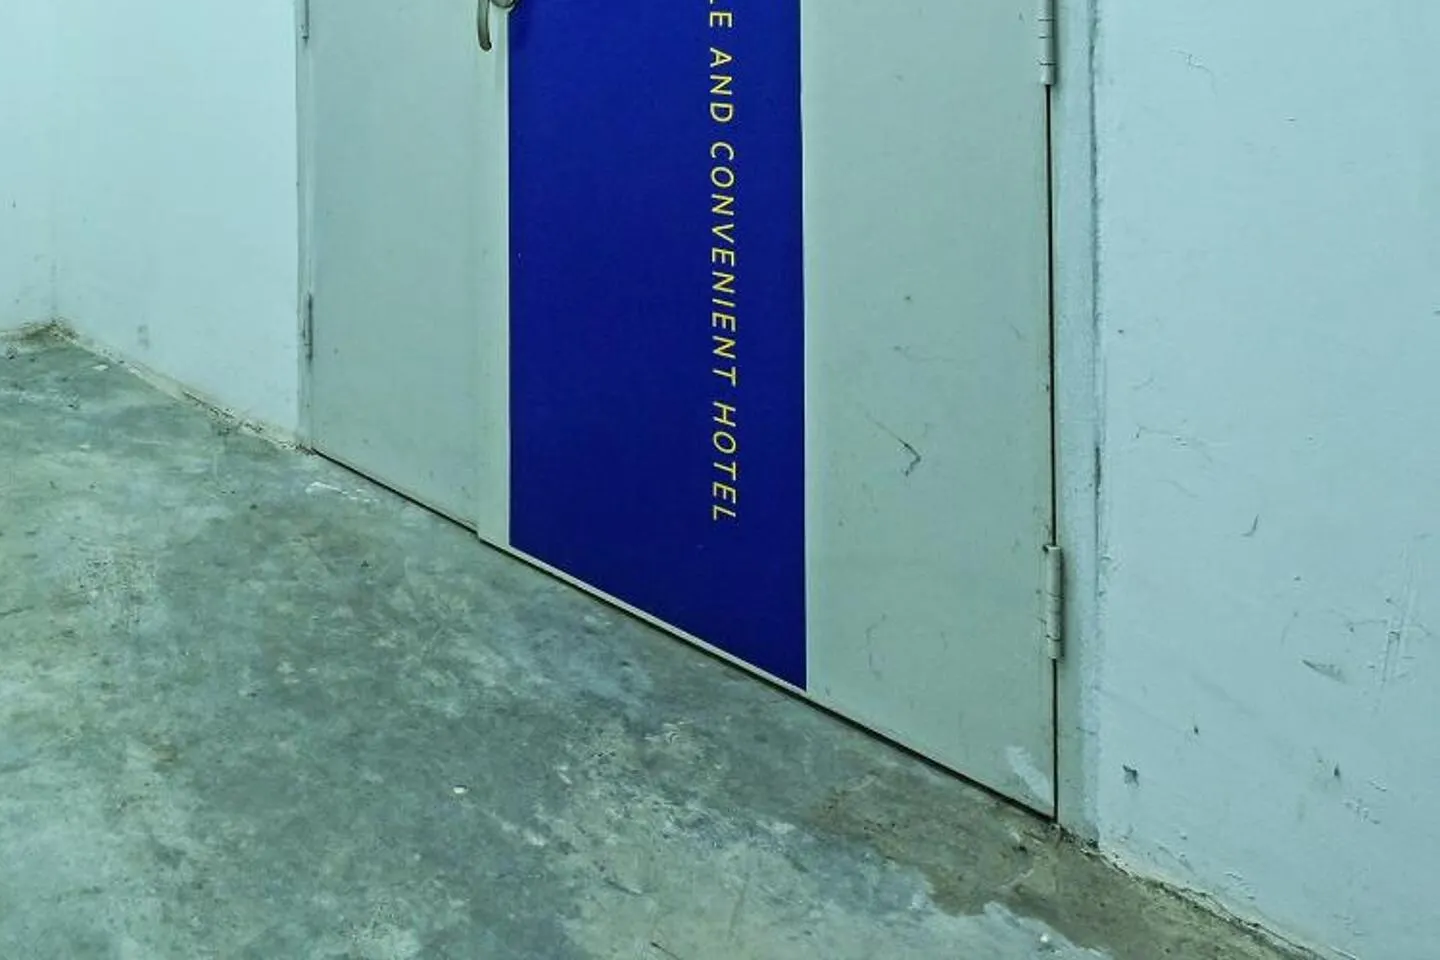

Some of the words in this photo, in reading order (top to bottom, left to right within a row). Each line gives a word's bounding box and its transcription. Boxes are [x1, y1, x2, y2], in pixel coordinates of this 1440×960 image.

[709, 46, 734, 123] AND
[710, 141, 737, 387] CONVENIENT
[712, 401, 737, 521] HOTEL
